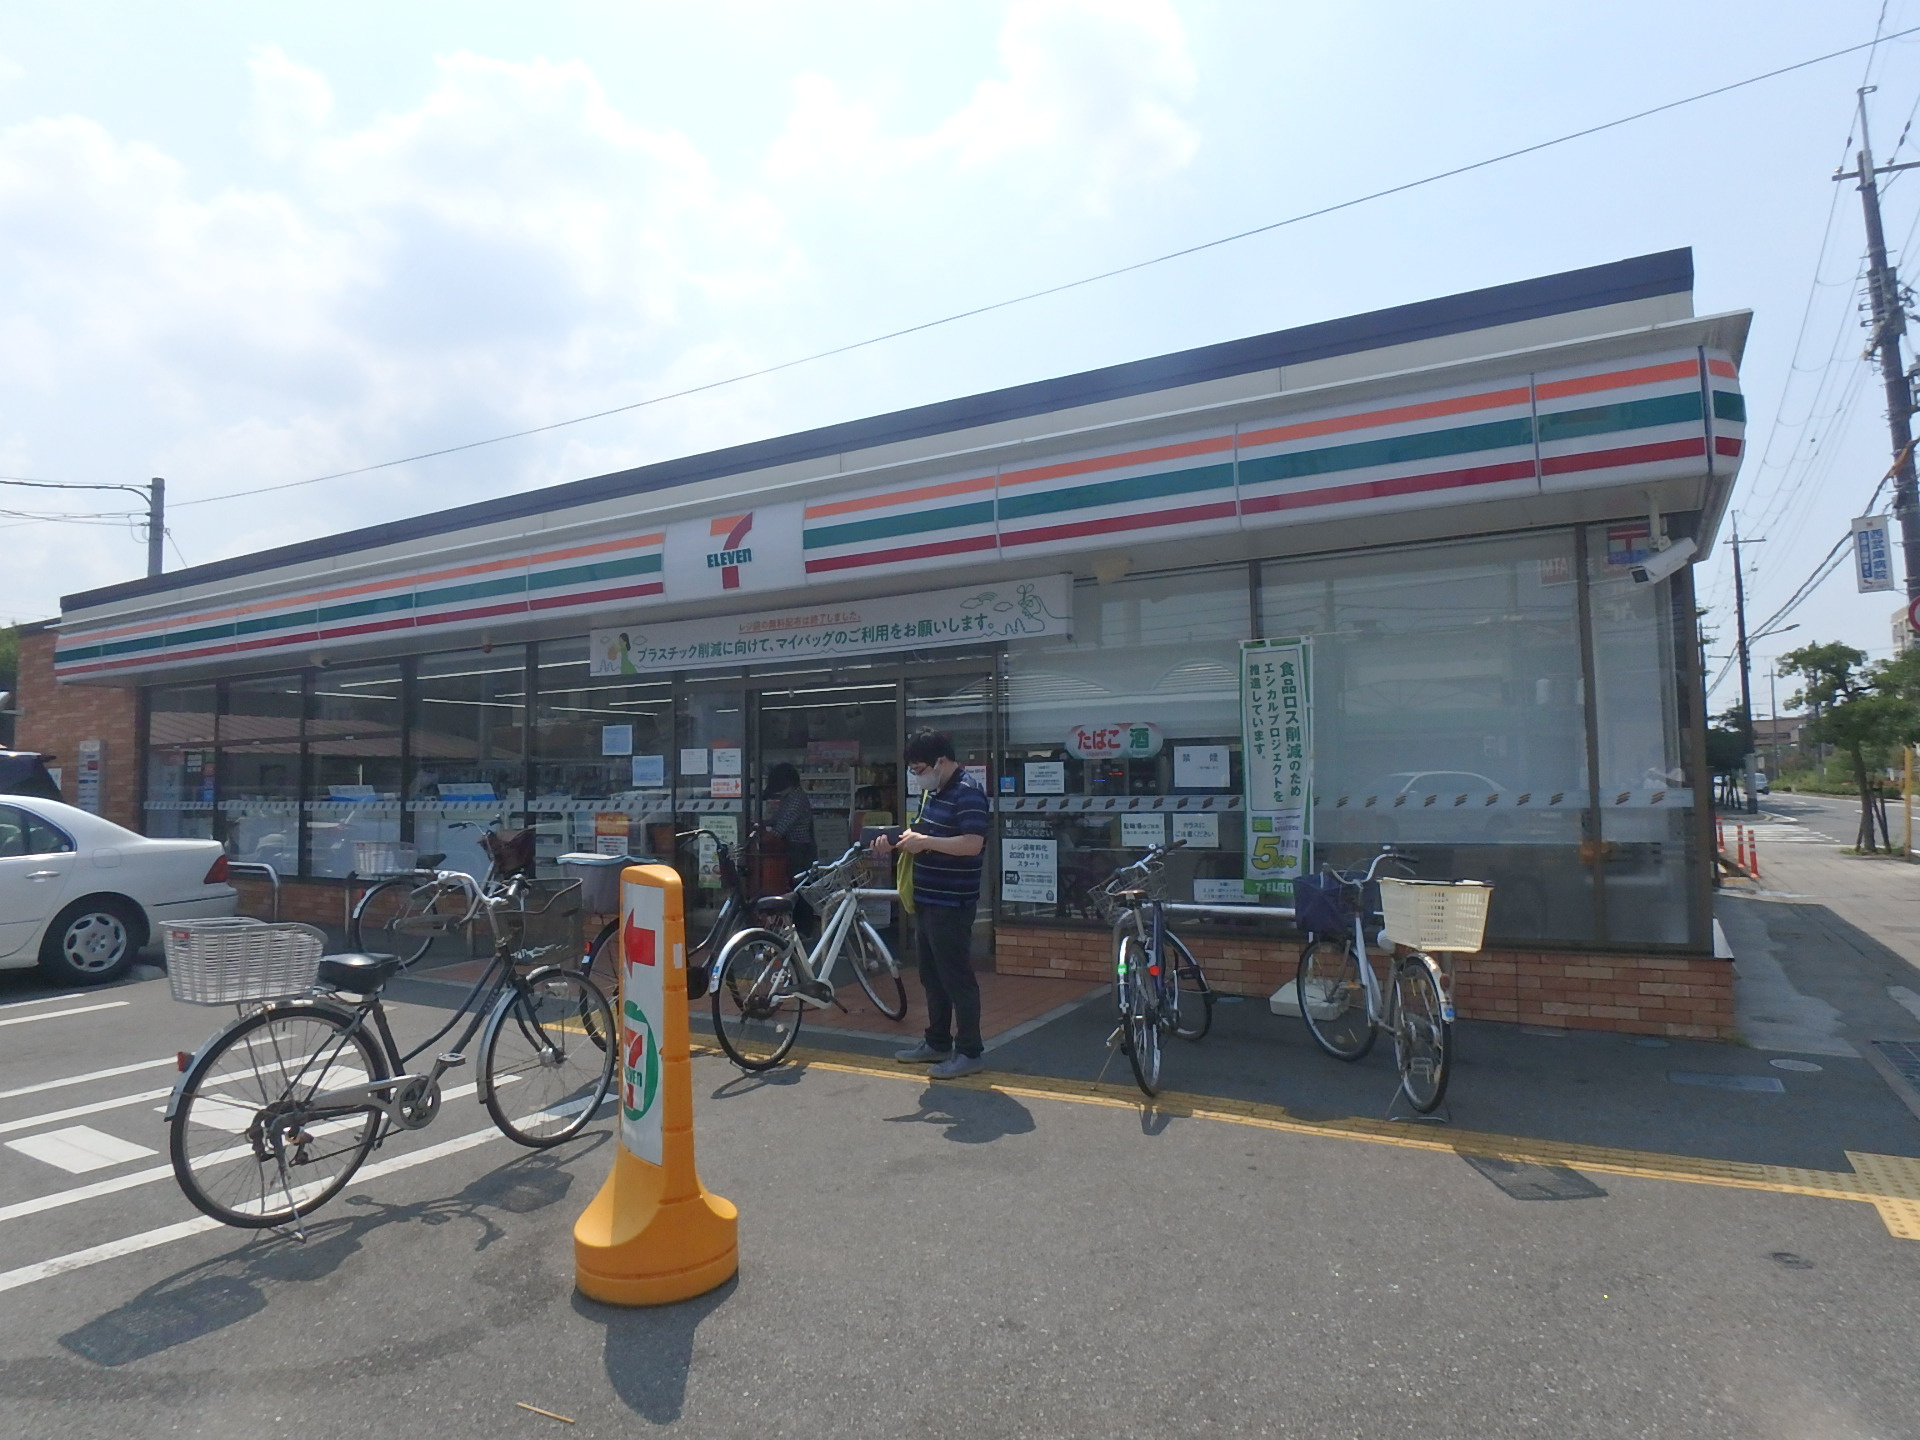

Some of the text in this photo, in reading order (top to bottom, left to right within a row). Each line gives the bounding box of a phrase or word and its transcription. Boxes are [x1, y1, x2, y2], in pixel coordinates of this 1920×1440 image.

[637, 613, 995, 662] プラスチック削減に向けて、マイバッグのご利用をお願いします。
[1078, 727, 1149, 750] たばこ 酒
[1249, 664, 1267, 760] 推進しています。
[1263, 662, 1284, 802] エシカルプロジェクトを
[1279, 661, 1303, 797] 食品ロス削減のため
